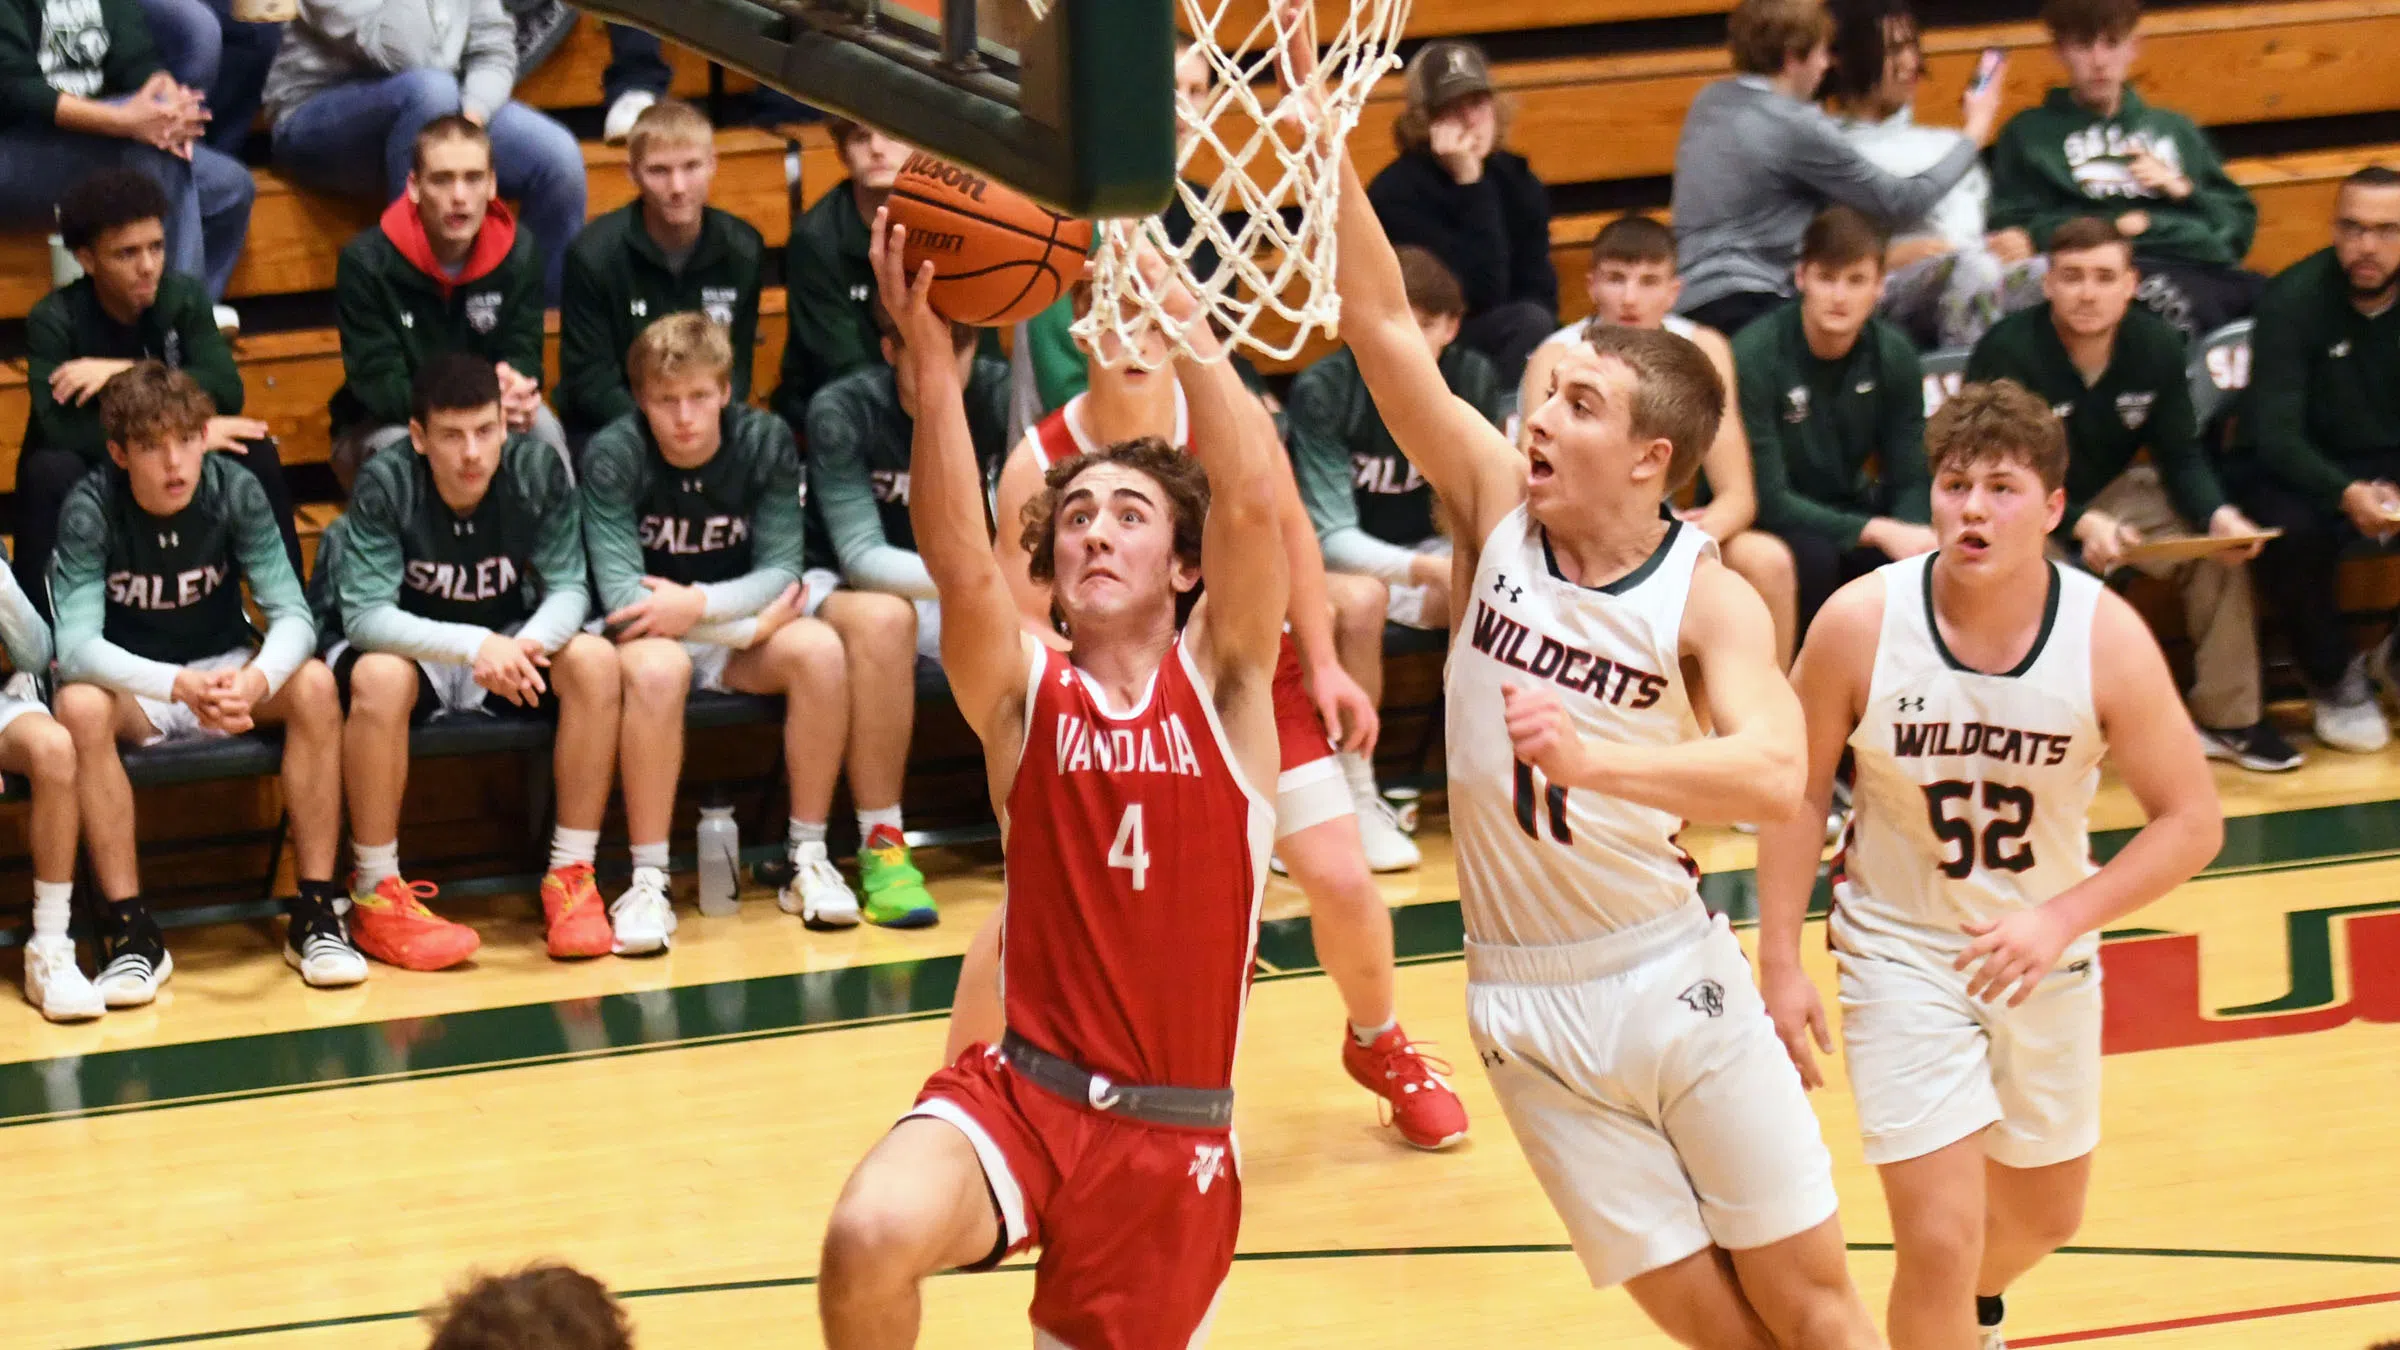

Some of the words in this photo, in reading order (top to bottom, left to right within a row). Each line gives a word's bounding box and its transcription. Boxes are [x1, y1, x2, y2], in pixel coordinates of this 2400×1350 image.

[1471, 597, 1669, 709] WILDCATS
[1893, 722, 2072, 766] WILDCATS
[1108, 803, 1151, 891] 4
[1918, 779, 2035, 879] 52
